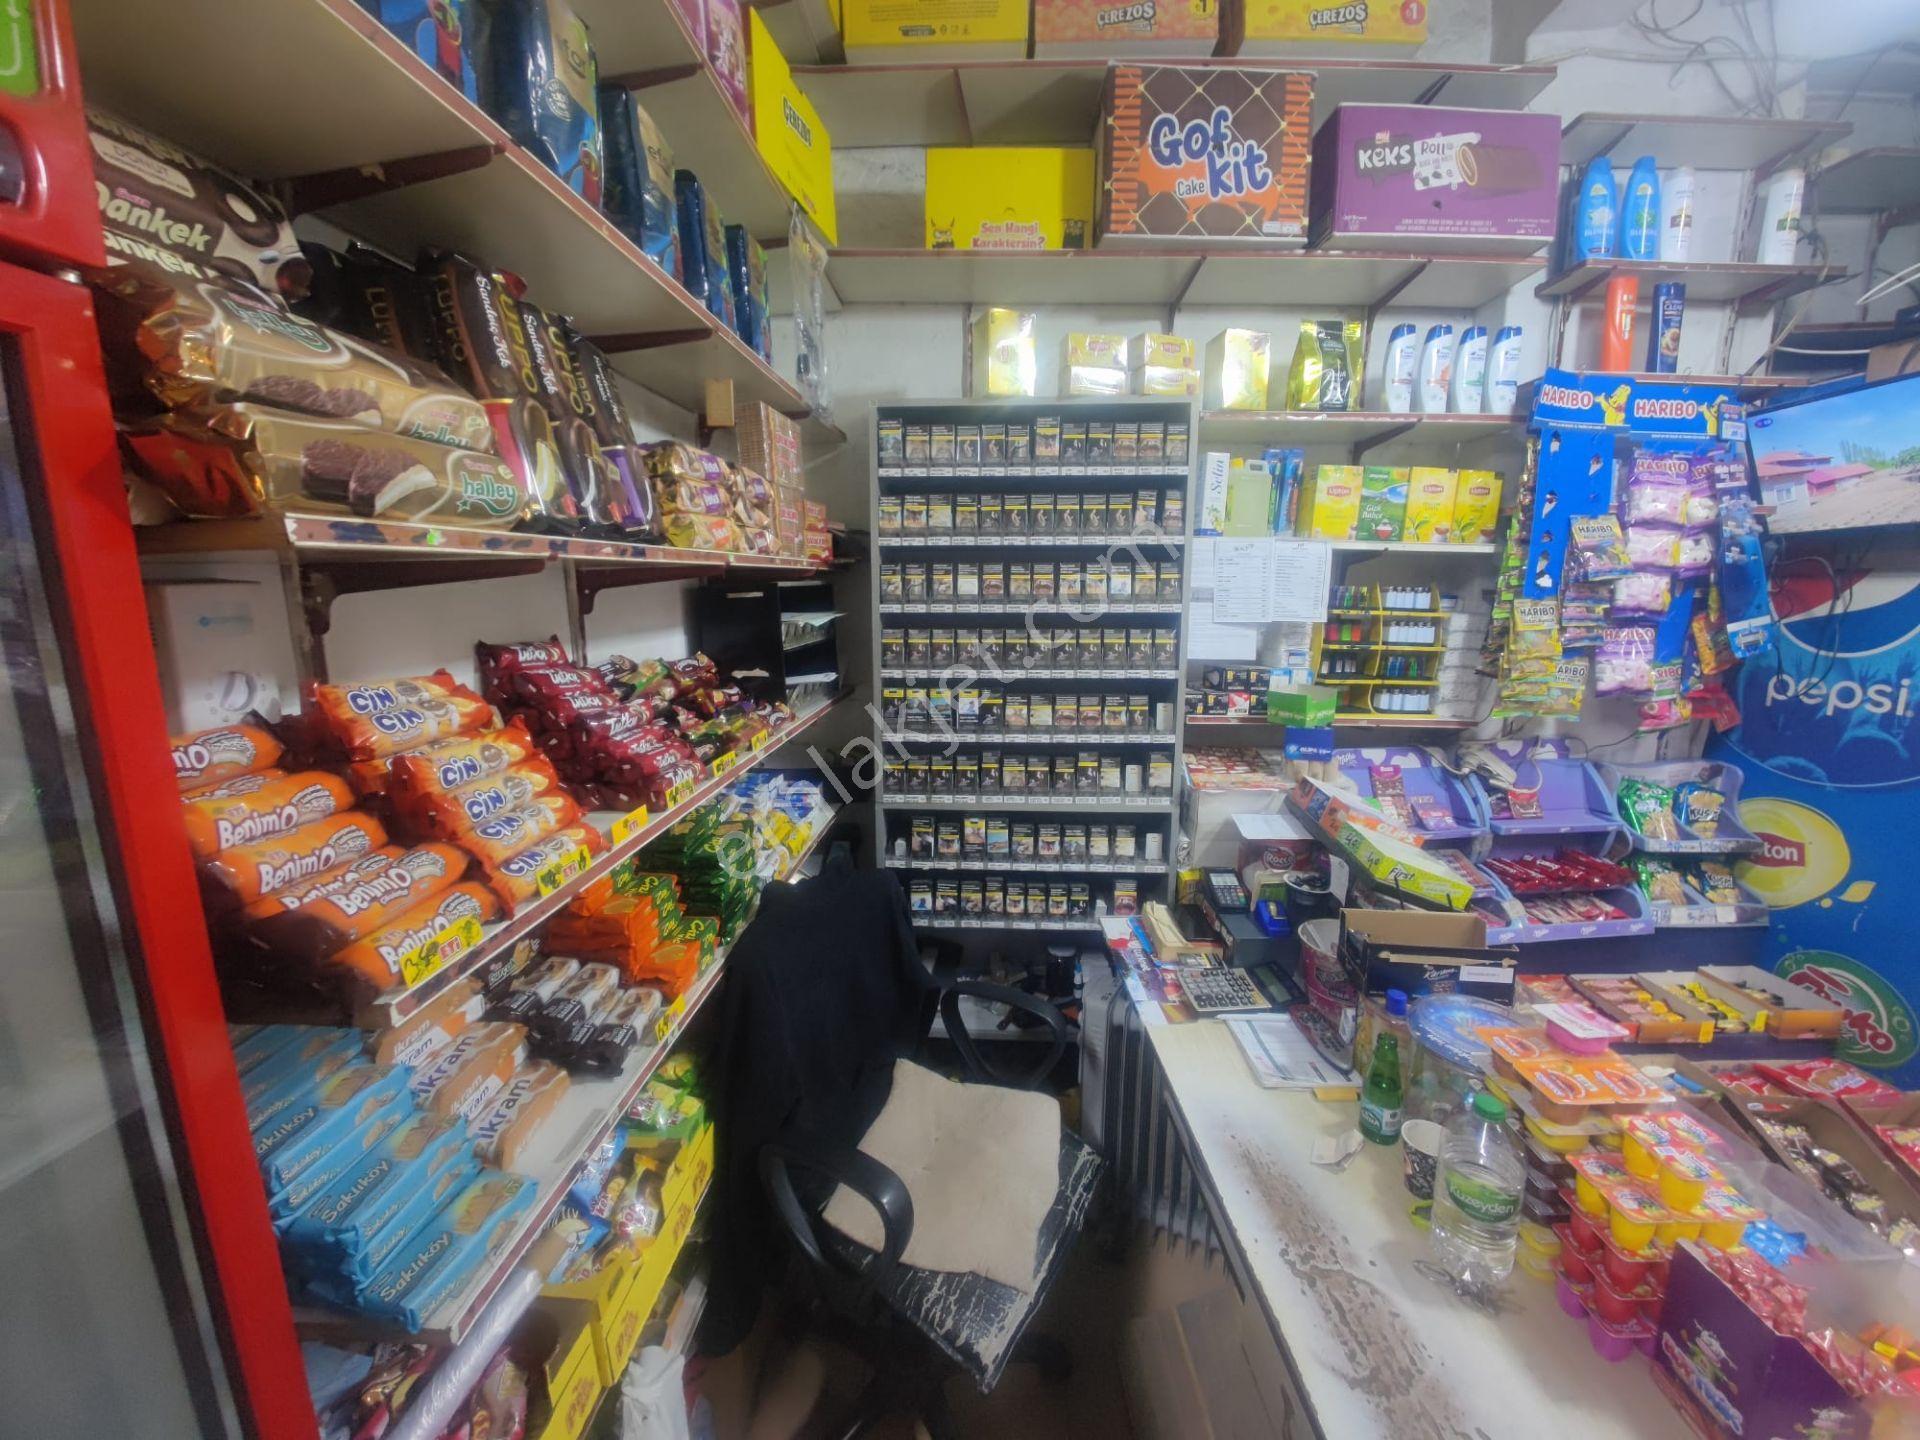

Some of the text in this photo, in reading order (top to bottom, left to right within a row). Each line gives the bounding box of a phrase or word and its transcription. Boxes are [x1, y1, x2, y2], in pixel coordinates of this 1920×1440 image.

[1308, 4, 1368, 32] ÇEREZOS
[1150, 106, 1232, 168] Gof
[1206, 140, 1272, 199] kit
[1176, 180, 1206, 197] Cake
[1005, 221, 1039, 237] Hangi
[972, 235, 1046, 250] Karaktersin?
[1540, 384, 1594, 410] HARIBO
[1634, 398, 1698, 419] HARIBO
[1636, 458, 1689, 474] HARIBO
[461, 472, 518, 515] halley
[1577, 524, 1614, 535] HARIBO
[1519, 606, 1556, 617] HARIBO
[1602, 627, 1656, 642] HARIBO
[1556, 664, 1586, 678] ARIBO
[1764, 673, 1910, 718] pepsi
[1764, 840, 1799, 862] ton
[258, 845, 337, 895] Benim'O
[1388, 866, 1416, 881] First
[256, 1106, 316, 1155] aklıköy
[1450, 1185, 1514, 1216] Kuzeyden
